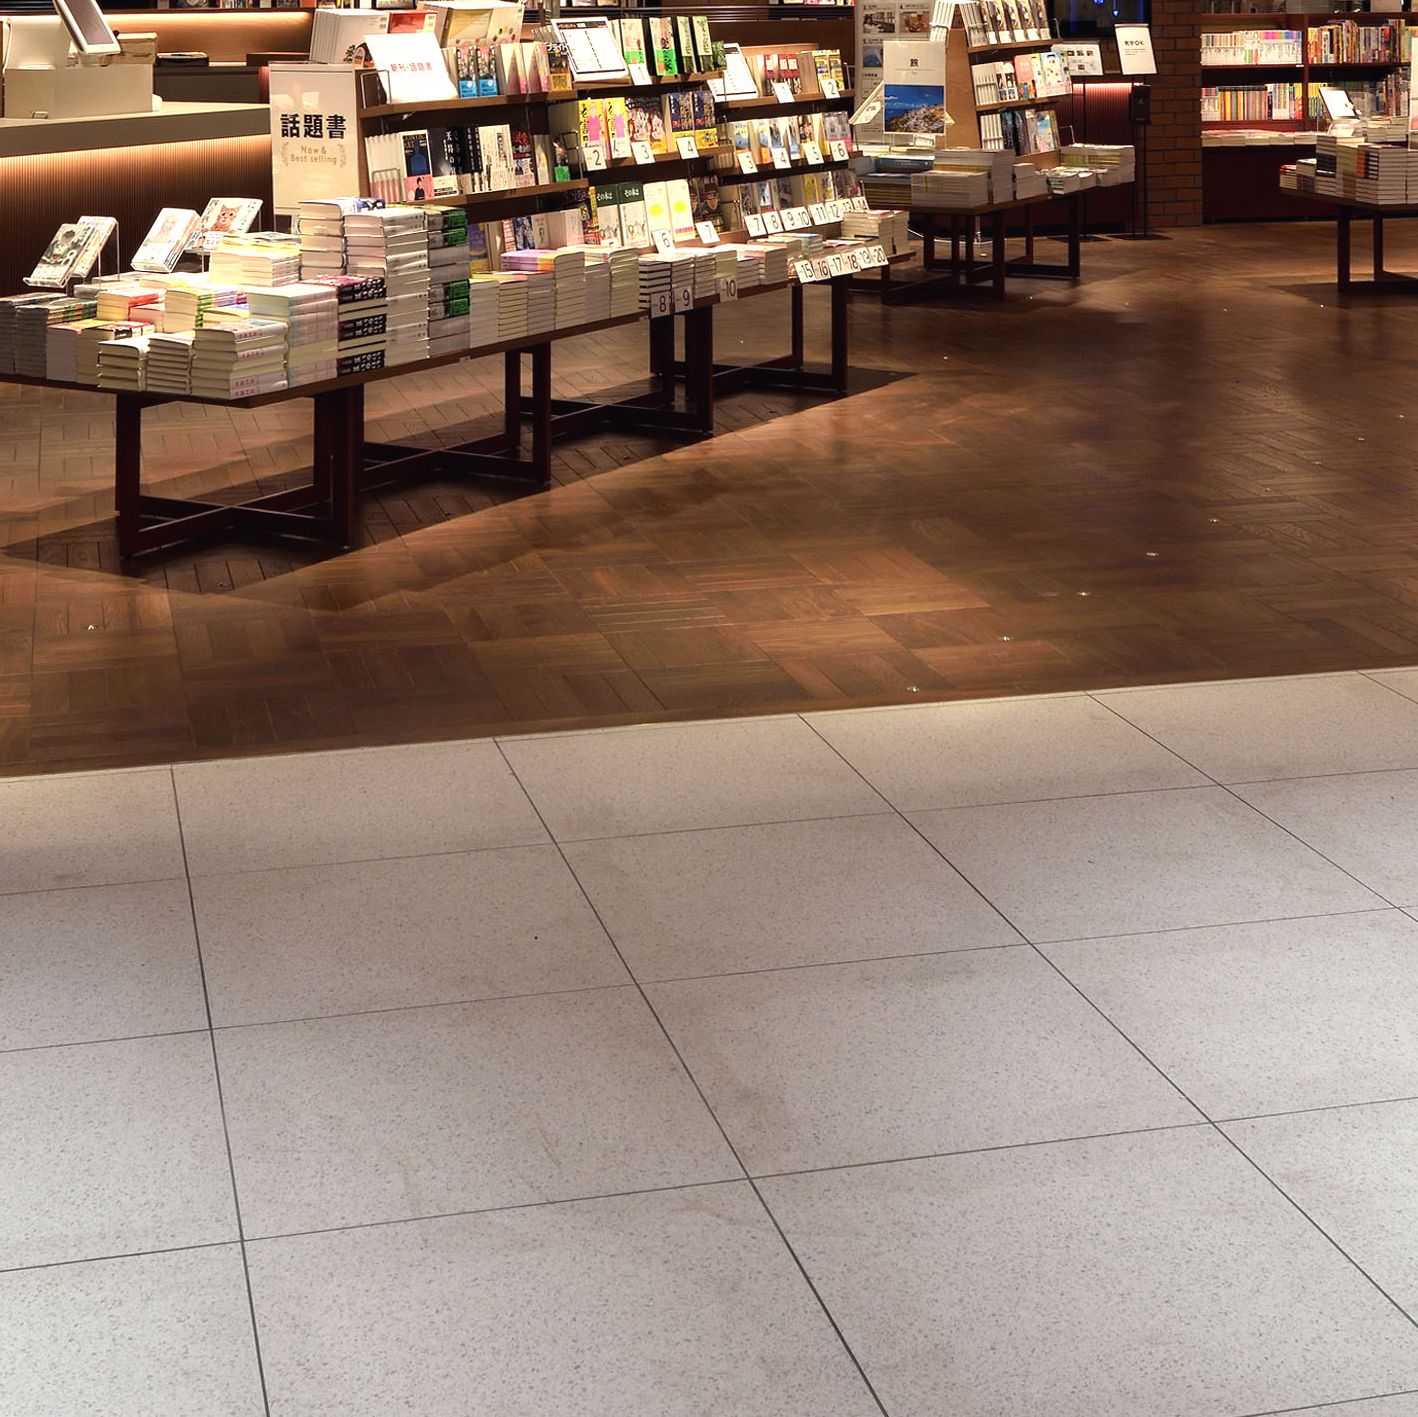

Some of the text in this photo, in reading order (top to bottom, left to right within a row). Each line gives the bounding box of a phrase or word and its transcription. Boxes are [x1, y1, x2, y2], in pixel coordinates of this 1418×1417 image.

[828, 82, 837, 95] 2
[280, 113, 347, 139] 話題書
[592, 149, 602, 167] 2
[641, 144, 650, 160] 3
[778, 151, 787, 165] 4
[811, 146, 821, 161] 5
[837, 143, 846, 158] 6
[290, 154, 337, 166] Best selling
[747, 156, 755, 171] 3
[787, 211, 795, 226] 9
[816, 206, 825, 221] 11
[829, 203, 840, 219] 12
[753, 217, 761, 232] 7
[770, 214, 780, 229] 8
[661, 231, 671, 248] 6
[847, 254, 859, 270] 18
[873, 248, 886, 263] 20
[801, 264, 814, 279] 15
[817, 260, 829, 276] 16
[833, 256, 844, 272] 17
[725, 280, 737, 297] 10
[659, 295, 667, 313] 8
[682, 289, 691, 307] 9
